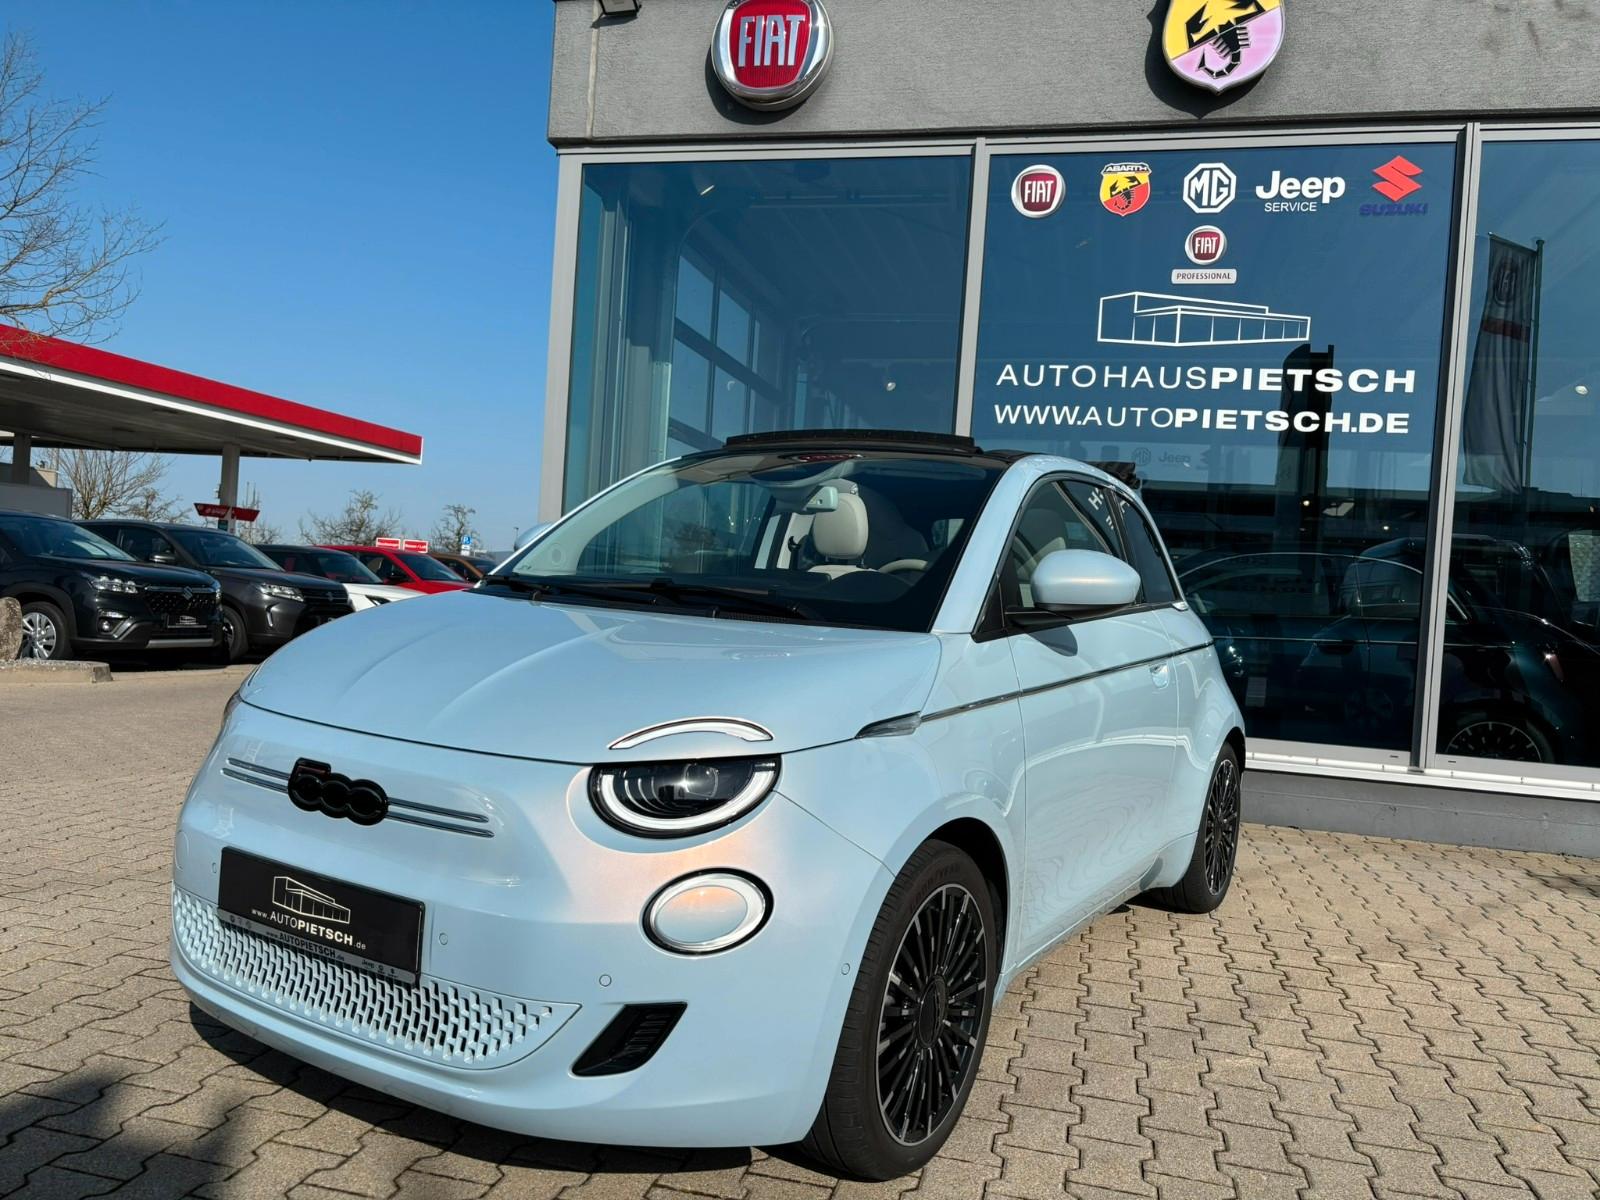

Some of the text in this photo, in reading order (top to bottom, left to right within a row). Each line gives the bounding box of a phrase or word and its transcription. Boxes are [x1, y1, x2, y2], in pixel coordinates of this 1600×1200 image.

[738, 15, 806, 67] FIAT
[1106, 164, 1148, 172] ABARTH
[1024, 180, 1054, 203] FIAT
[1189, 169, 1230, 207] MG
[1255, 170, 1346, 204] Jeep
[1264, 202, 1318, 212] SERVICE
[1359, 203, 1429, 216] SUZUKI
[1194, 236, 1218, 254] FIAT
[1176, 272, 1232, 281] PROFESSIONAL
[995, 363, 1416, 393] AUTOHAUSPIETSCH
[993, 403, 1410, 434] WWW.AUTOPIETSCH.DE
[287, 757, 389, 826] 500
[251, 908, 367, 950] www.AUTOPIETSCH.de
